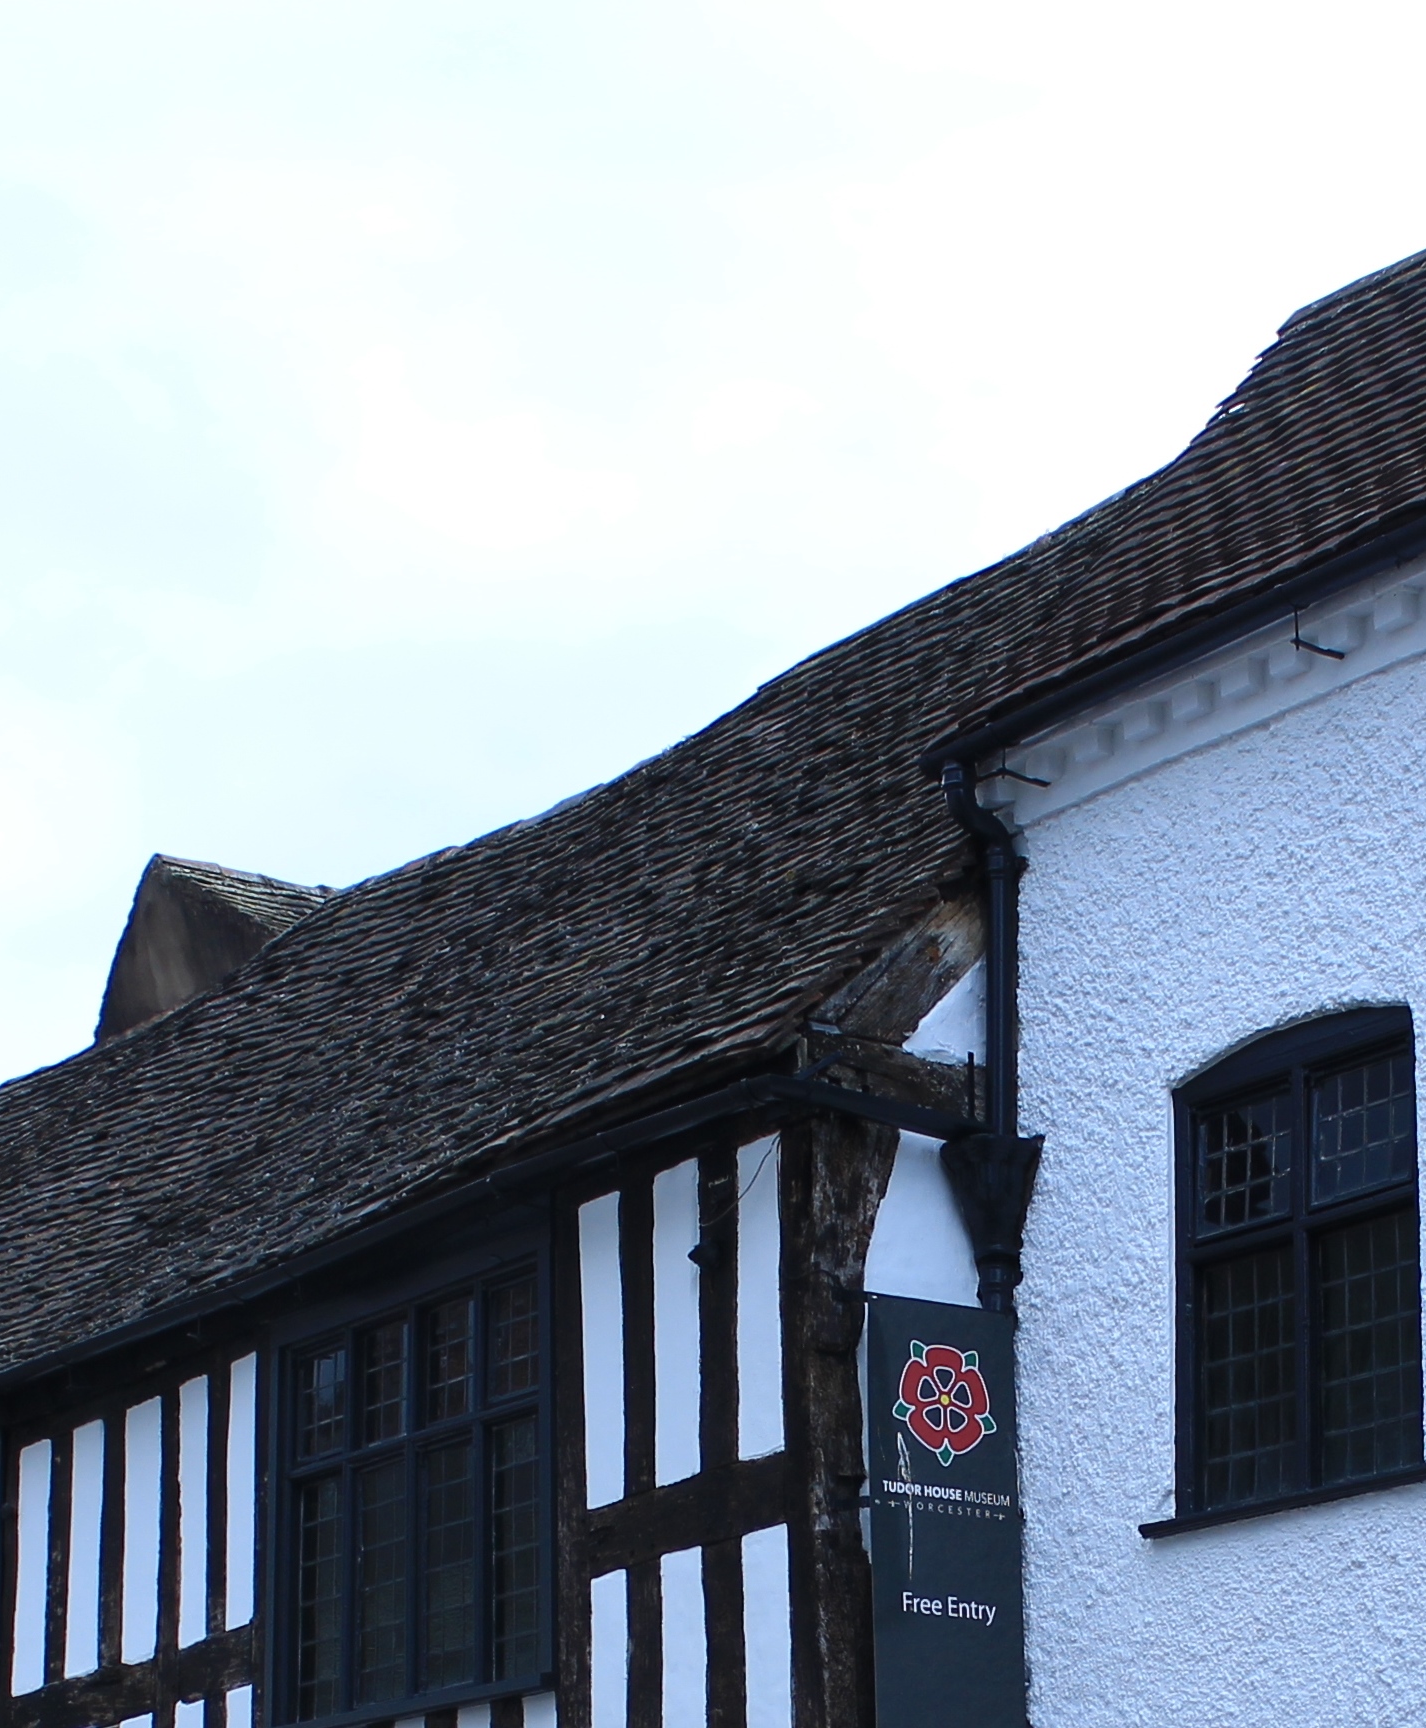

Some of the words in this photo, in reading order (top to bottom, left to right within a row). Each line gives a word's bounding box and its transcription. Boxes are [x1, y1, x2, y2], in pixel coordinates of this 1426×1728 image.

[882, 1480, 922, 1497] TUDOR
[924, 1485, 962, 1501] HOUSE
[964, 1490, 1010, 1507] MUSEUM
[903, 1500, 991, 1519] WORCESTER
[902, 1591, 943, 1616] Free
[947, 1595, 996, 1627] Entry
